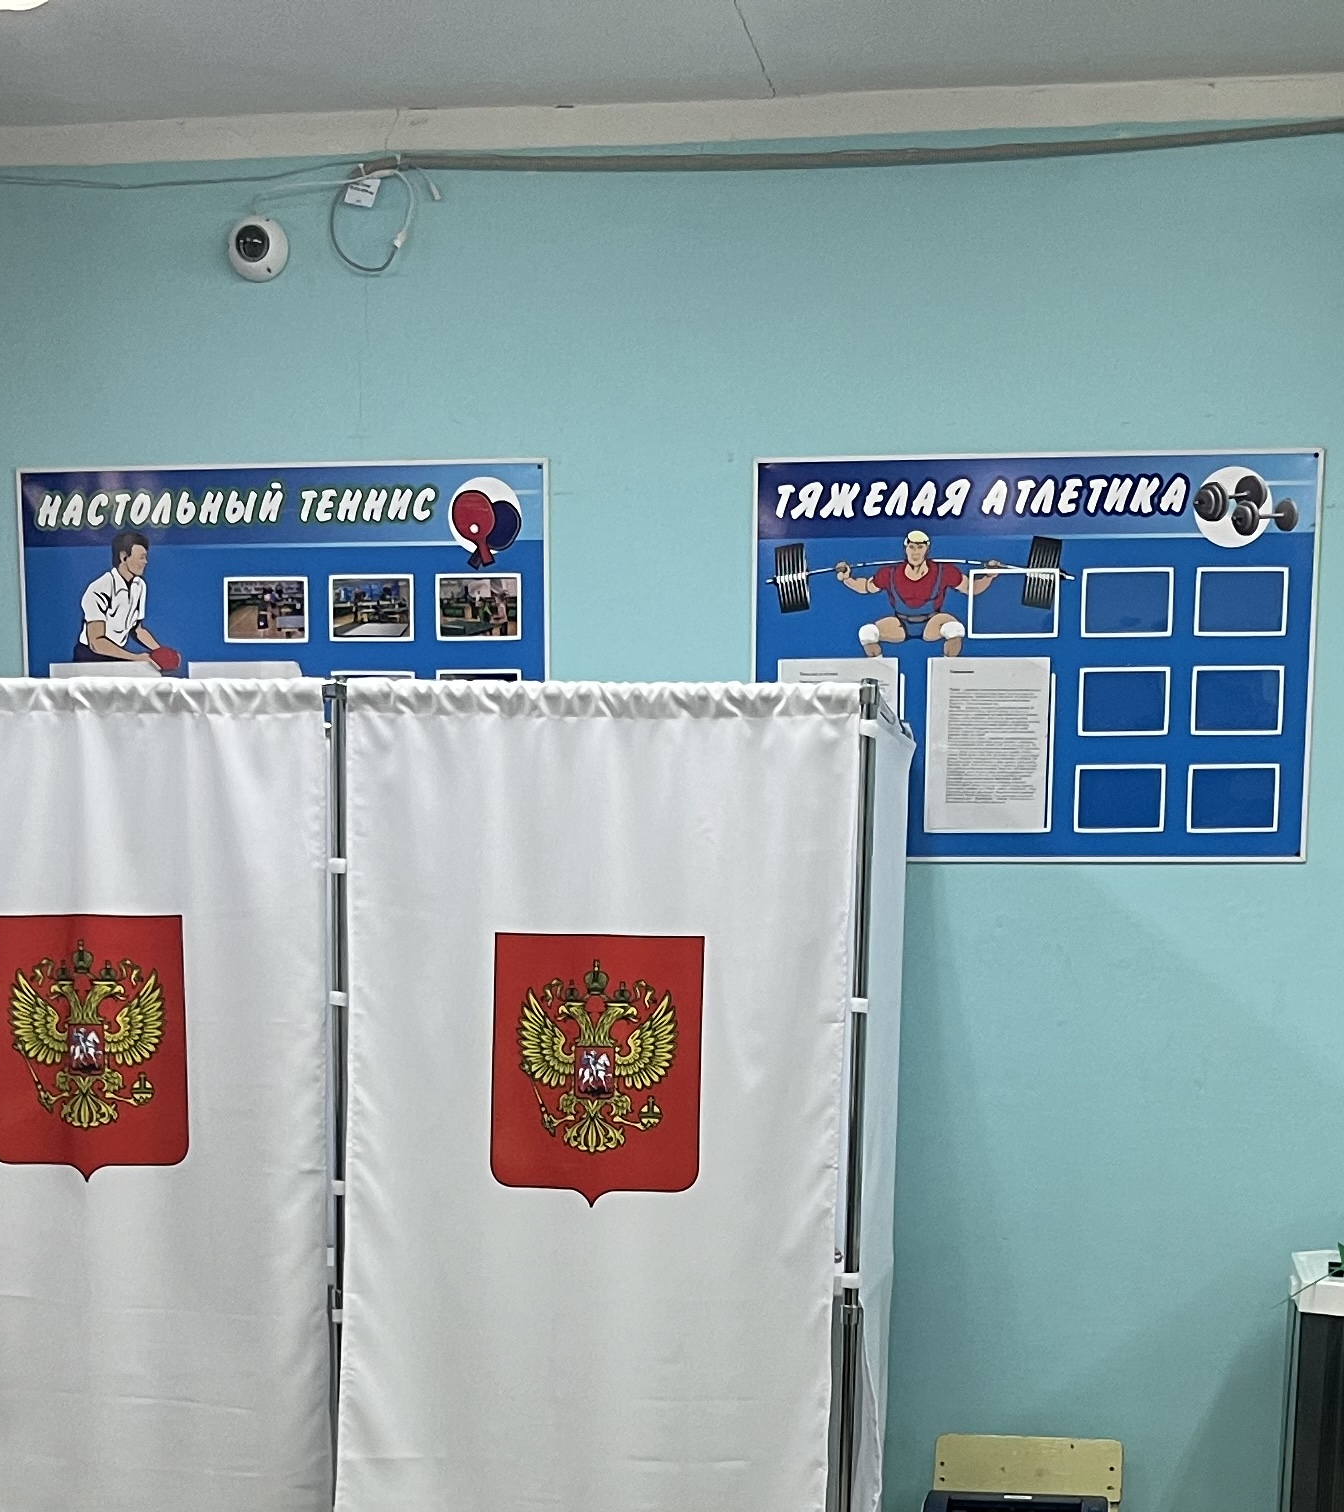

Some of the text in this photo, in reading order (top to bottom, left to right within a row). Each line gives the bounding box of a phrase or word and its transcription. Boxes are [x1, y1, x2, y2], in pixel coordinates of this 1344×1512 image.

[37, 481, 437, 527] НАСТОЛЬНЫЙ ТЕННИС
[775, 477, 1189, 521] ТЯЖЕЛАЯ АТЛЕТИКА
